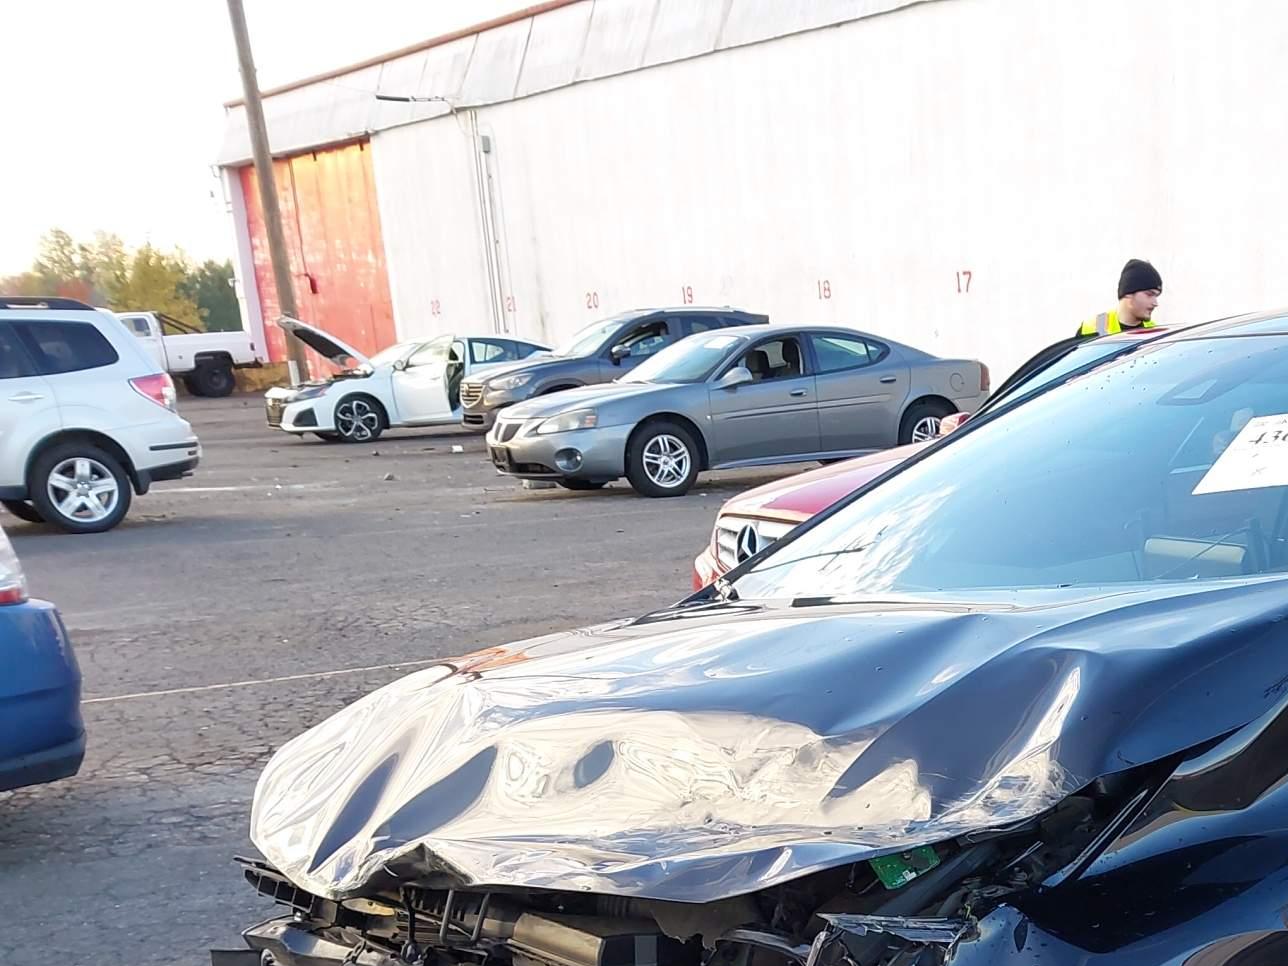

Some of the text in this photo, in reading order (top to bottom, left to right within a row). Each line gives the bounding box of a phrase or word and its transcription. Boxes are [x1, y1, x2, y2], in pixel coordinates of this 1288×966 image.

[816, 279, 832, 301] 18
[956, 270, 973, 294] 17
[585, 291, 600, 310] 20
[680, 285, 694, 305] 19
